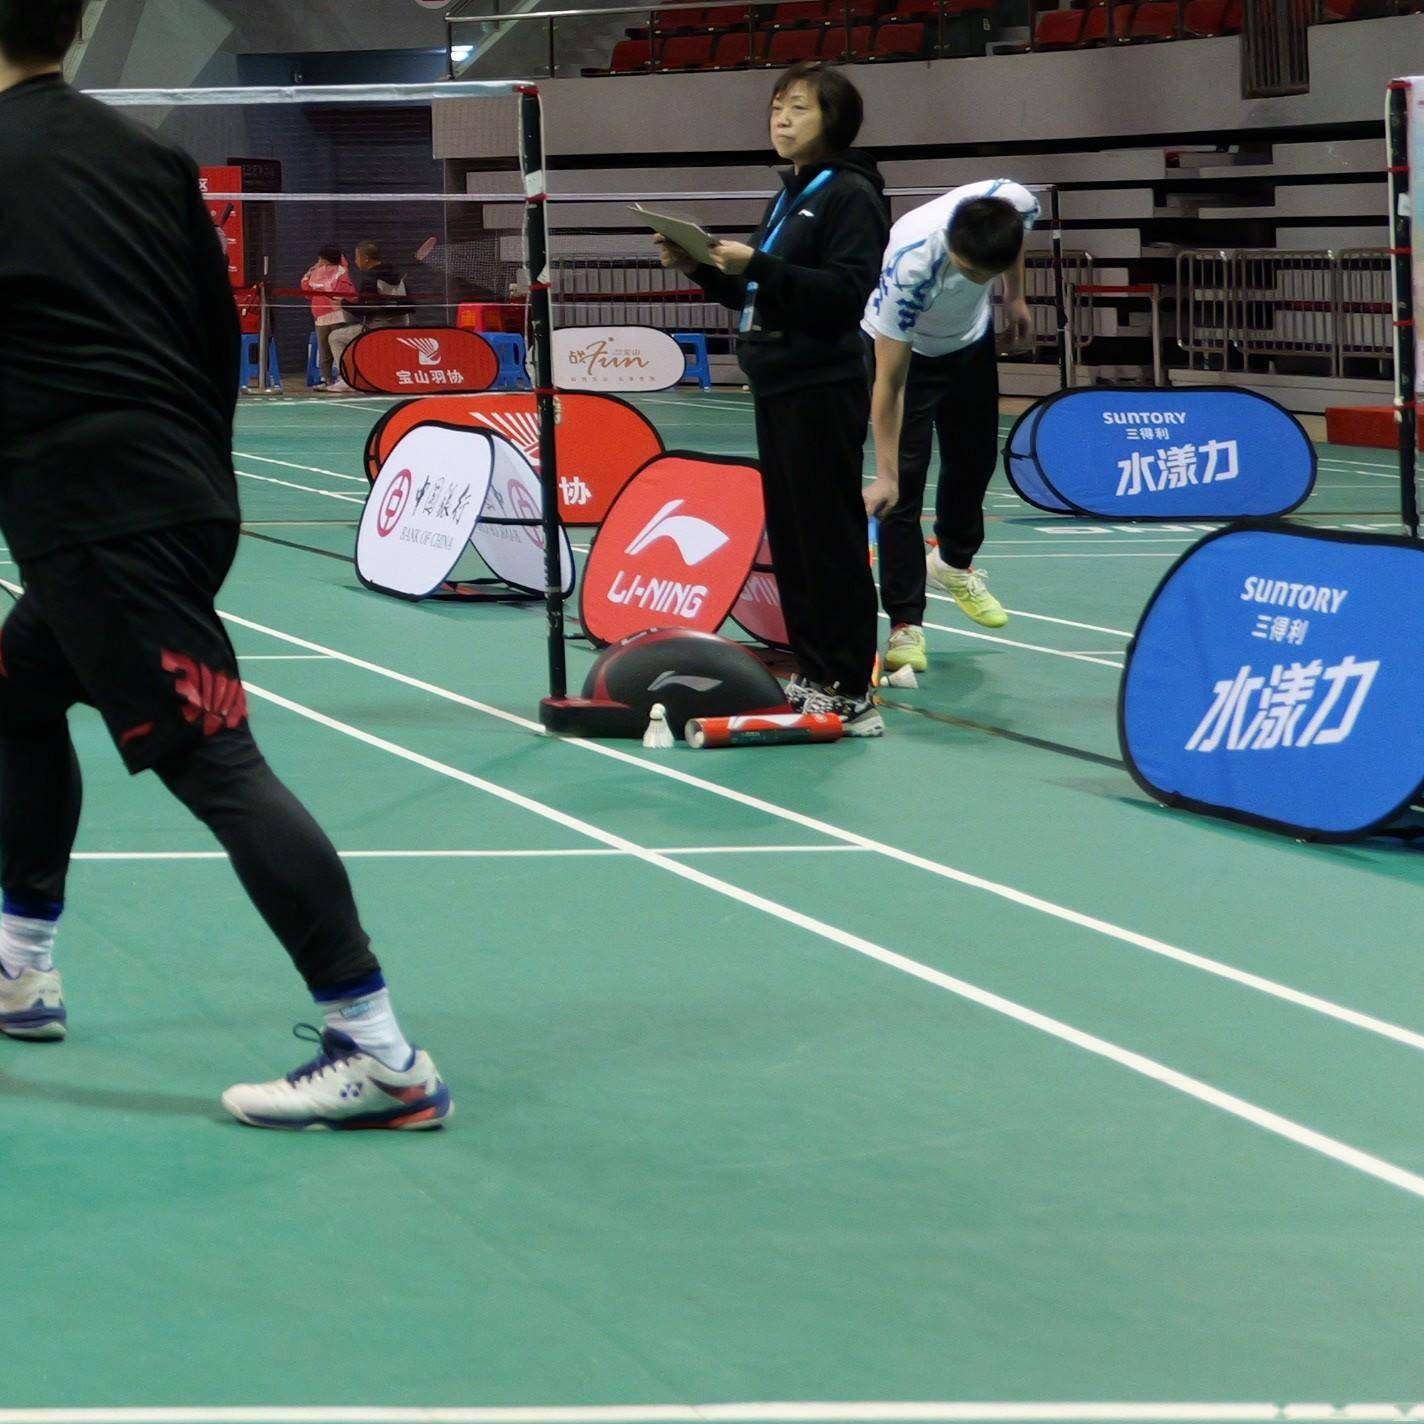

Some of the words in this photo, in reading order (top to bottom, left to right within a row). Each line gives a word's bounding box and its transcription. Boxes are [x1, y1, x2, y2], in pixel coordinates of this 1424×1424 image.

[397, 369, 465, 385] 宝山羽协
[1126, 427, 1170, 441] 三得利
[1116, 439, 1240, 497] 水漾力
[400, 526, 420, 544] BANK
[606, 570, 710, 619] LI-NING
[1251, 614, 1310, 645] 三得利
[1184, 655, 1380, 753] 水漾力
